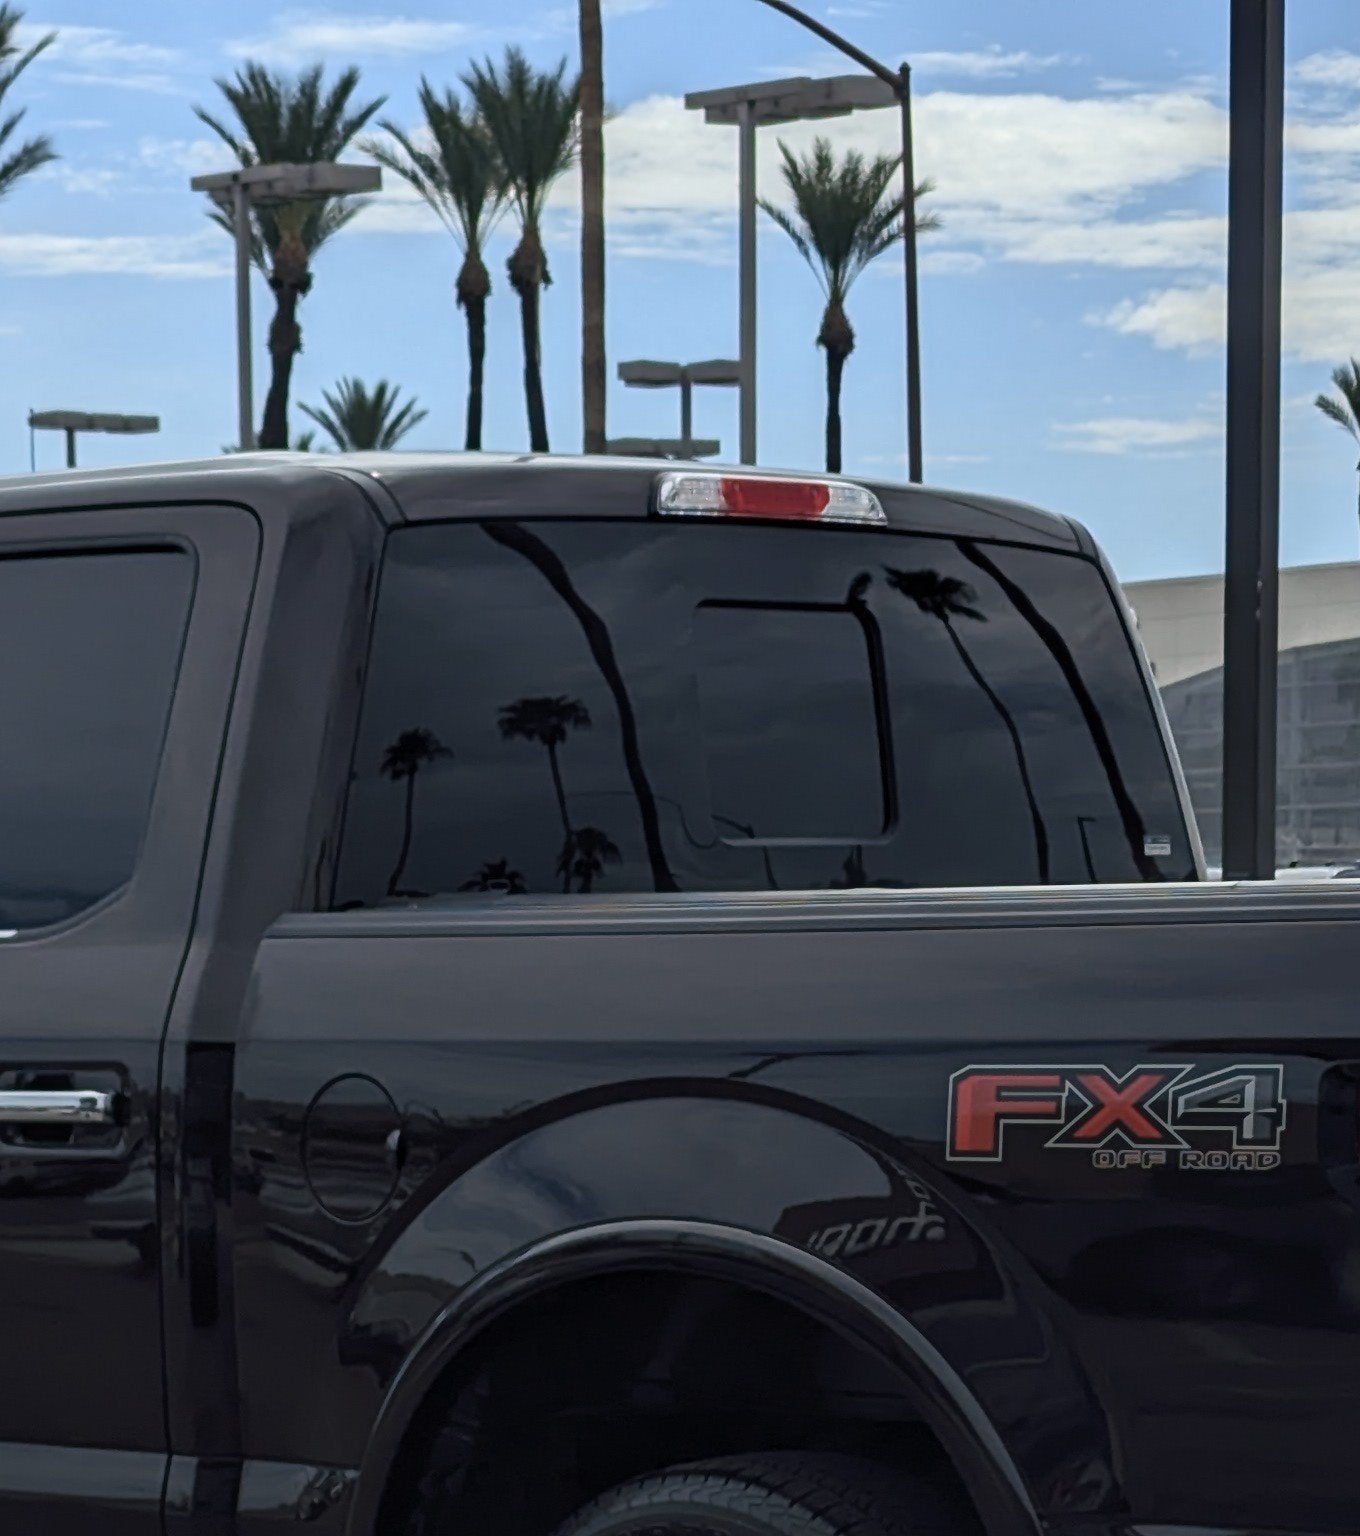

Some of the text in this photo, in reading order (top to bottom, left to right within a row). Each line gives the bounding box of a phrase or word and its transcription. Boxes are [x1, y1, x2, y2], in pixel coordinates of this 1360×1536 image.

[946, 1063, 1286, 1161] FX4
[1092, 1150, 1281, 1170] OFF ROAD
